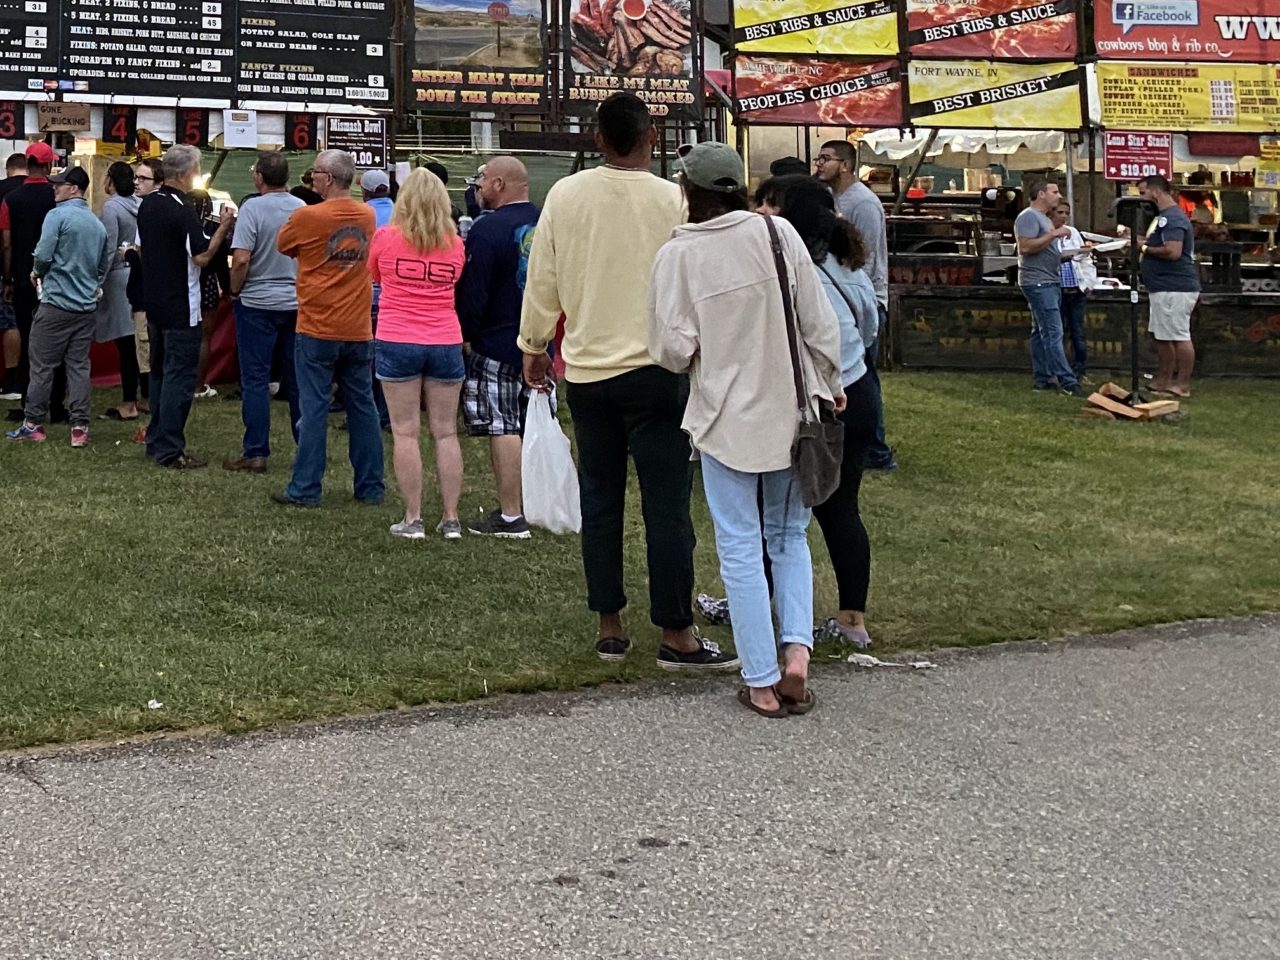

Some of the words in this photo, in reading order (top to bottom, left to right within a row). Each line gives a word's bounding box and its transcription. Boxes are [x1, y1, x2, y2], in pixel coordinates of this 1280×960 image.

[744, 23, 776, 40] BEST
[780, 16, 811, 33] RIBS
[814, 14, 823, 26] &
[825, 5, 867, 25] SAUCE
[1137, 10, 1192, 22] Facebook
[1098, 38, 1144, 52] cowboys
[1147, 39, 1168, 54] bbq
[1172, 36, 1180, 52] &
[1186, 39, 1201, 52] rib
[412, 70, 463, 84] BETTER
[468, 72, 504, 86] MEAT
[509, 73, 544, 87] THAN
[914, 67, 942, 76] FORT
[945, 67, 985, 78] WAYNE,
[987, 68, 998, 77] IN
[574, 75, 580, 88] I
[584, 76, 619, 89] LIKE
[623, 77, 646, 90] MY
[650, 78, 690, 90] MEAT
[416, 89, 456, 103] DOWN
[460, 90, 488, 104] THE
[492, 91, 540, 105] STREET
[635, 91, 694, 104] SMOKED
[933, 95, 973, 114] BEST
[980, 78, 1048, 103] BRISKET
[40, 105, 63, 114] GONE
[51, 117, 86, 127] BUCKING
[111, 116, 128, 140] 4
[185, 120, 201, 145] 5
[293, 125, 308, 149] 6
